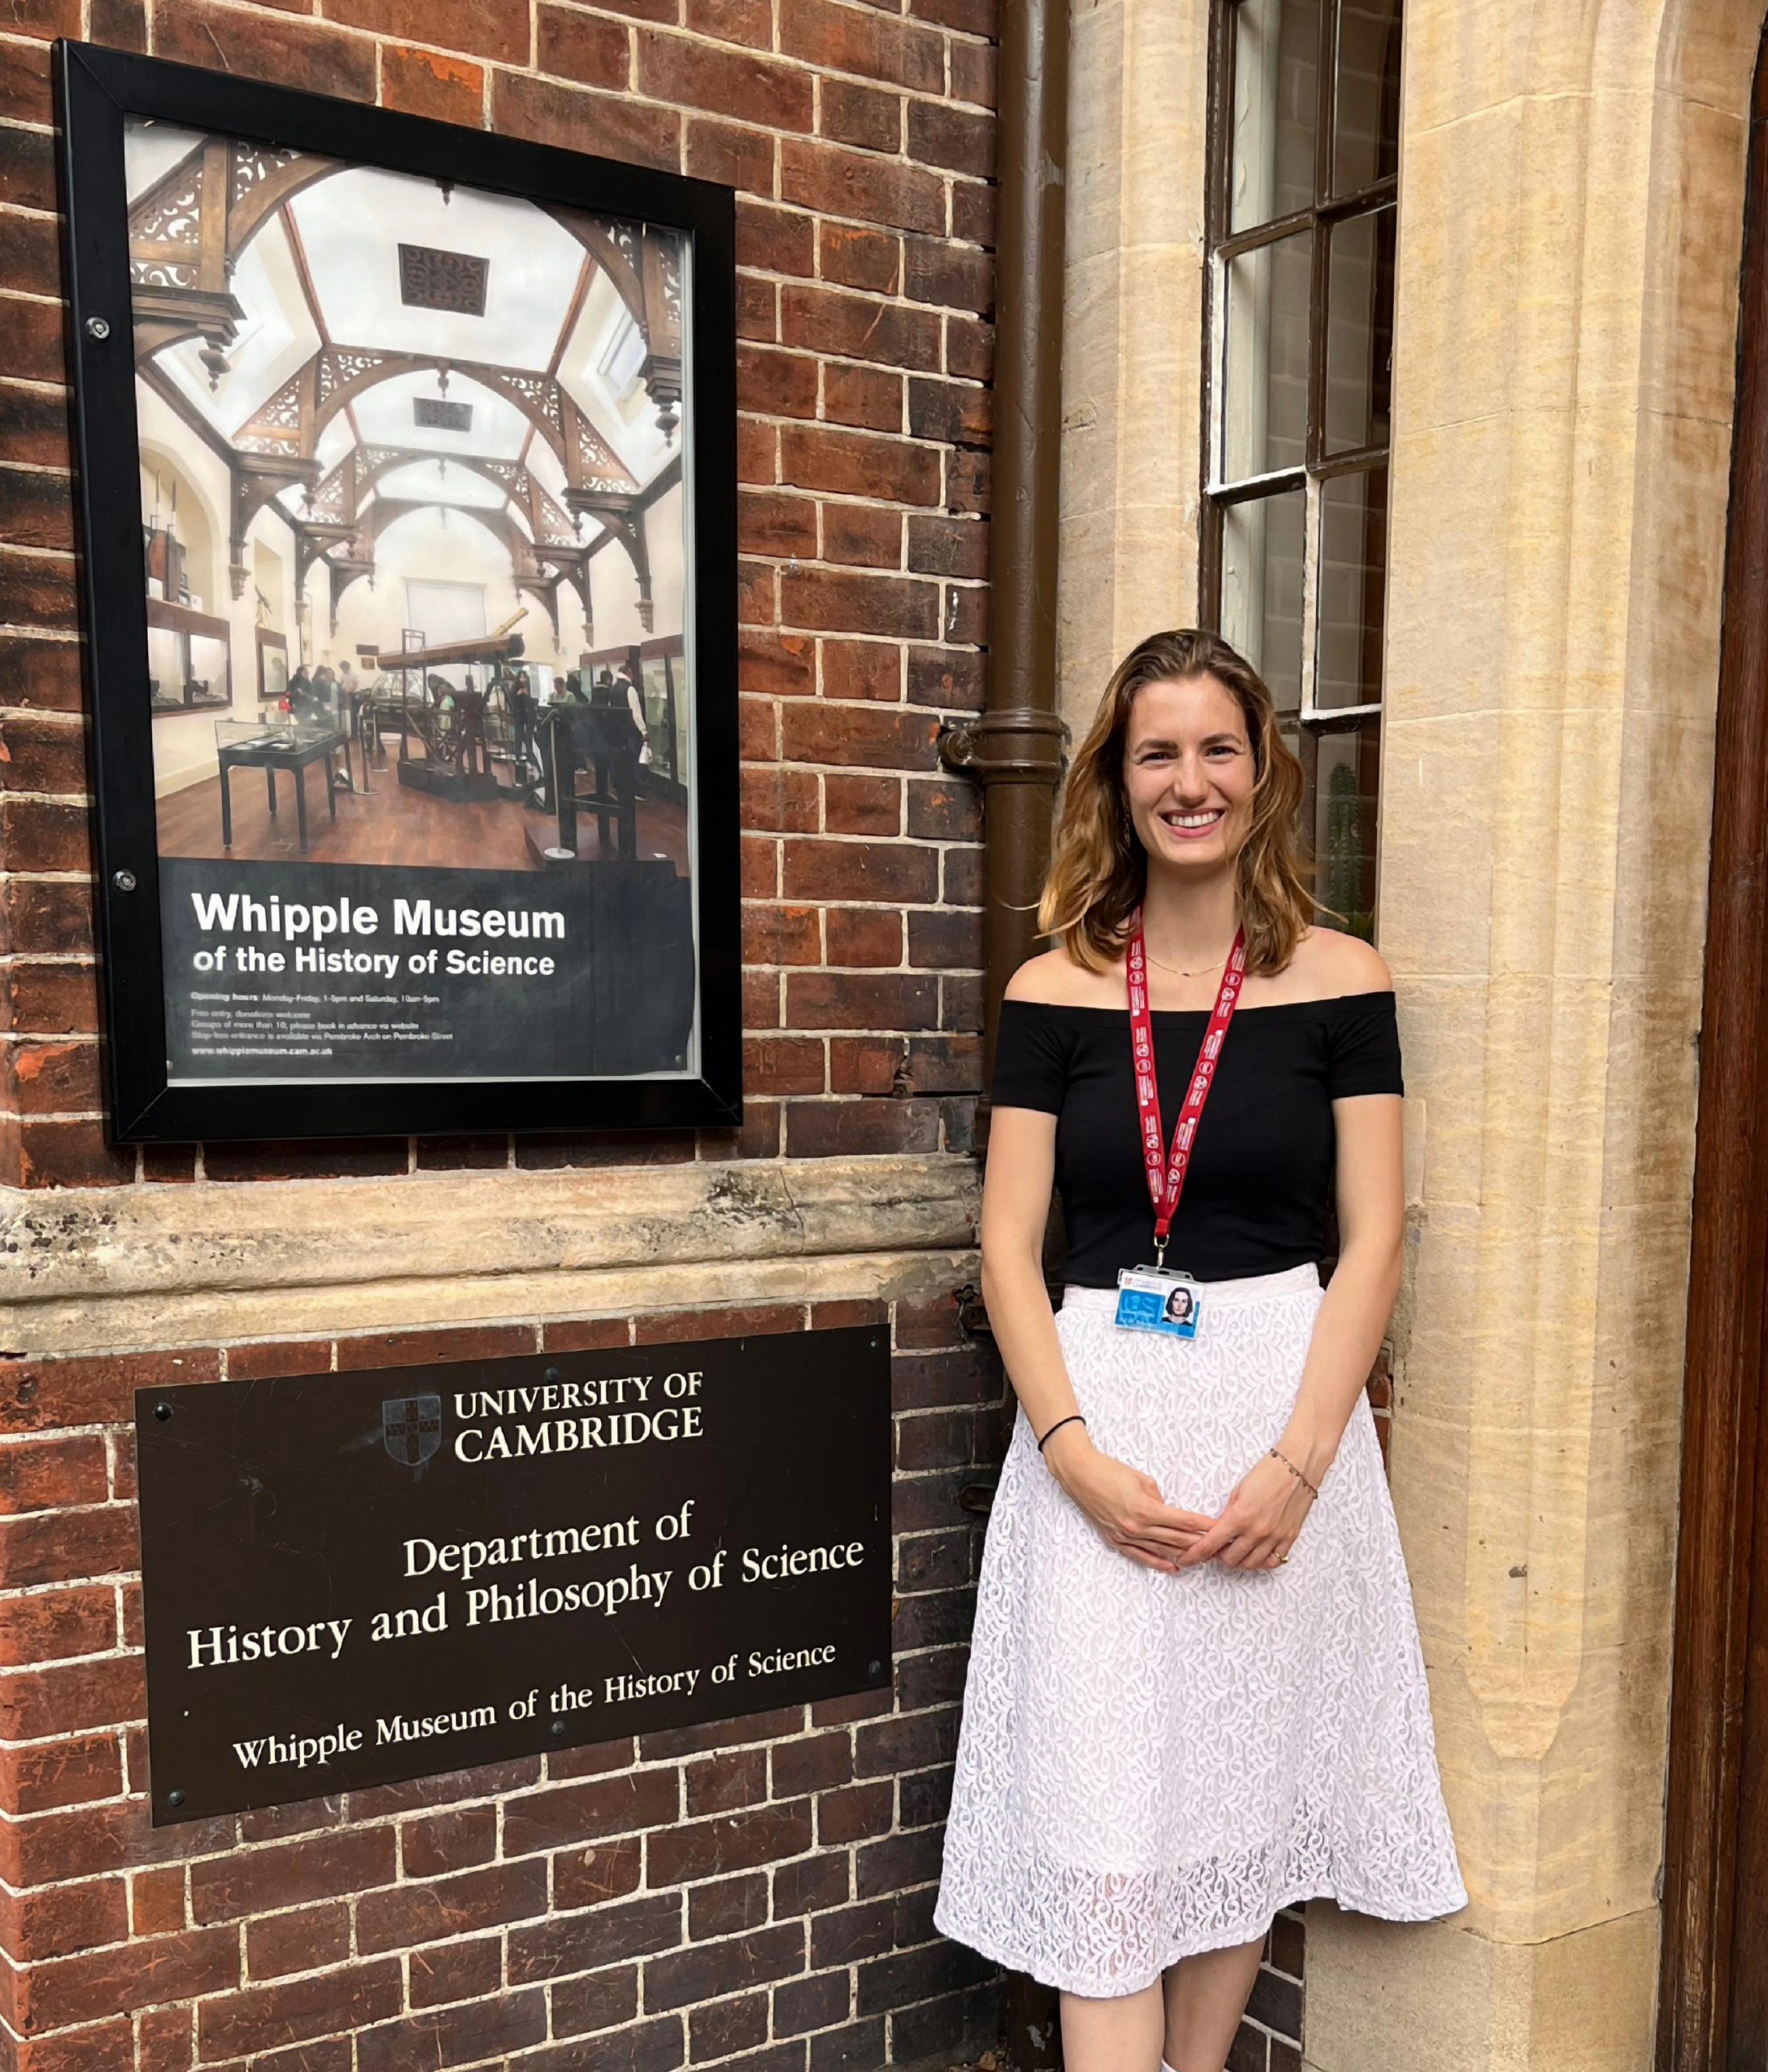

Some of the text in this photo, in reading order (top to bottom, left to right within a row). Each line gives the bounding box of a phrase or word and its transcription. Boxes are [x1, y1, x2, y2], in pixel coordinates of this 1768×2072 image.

[190, 892, 565, 942] Whipple Museum
[193, 945, 555, 979] of the History of Science
[255, 1021, 273, 1029] than
[454, 1371, 703, 1420] UNIVERSITY OF
[454, 1406, 703, 1464] CAMBRIDGE
[403, 1500, 695, 1580] Department of
[186, 1542, 864, 1669] History and Philosophy of Science
[233, 1645, 836, 1769] Whipple Museum of the History of Science
